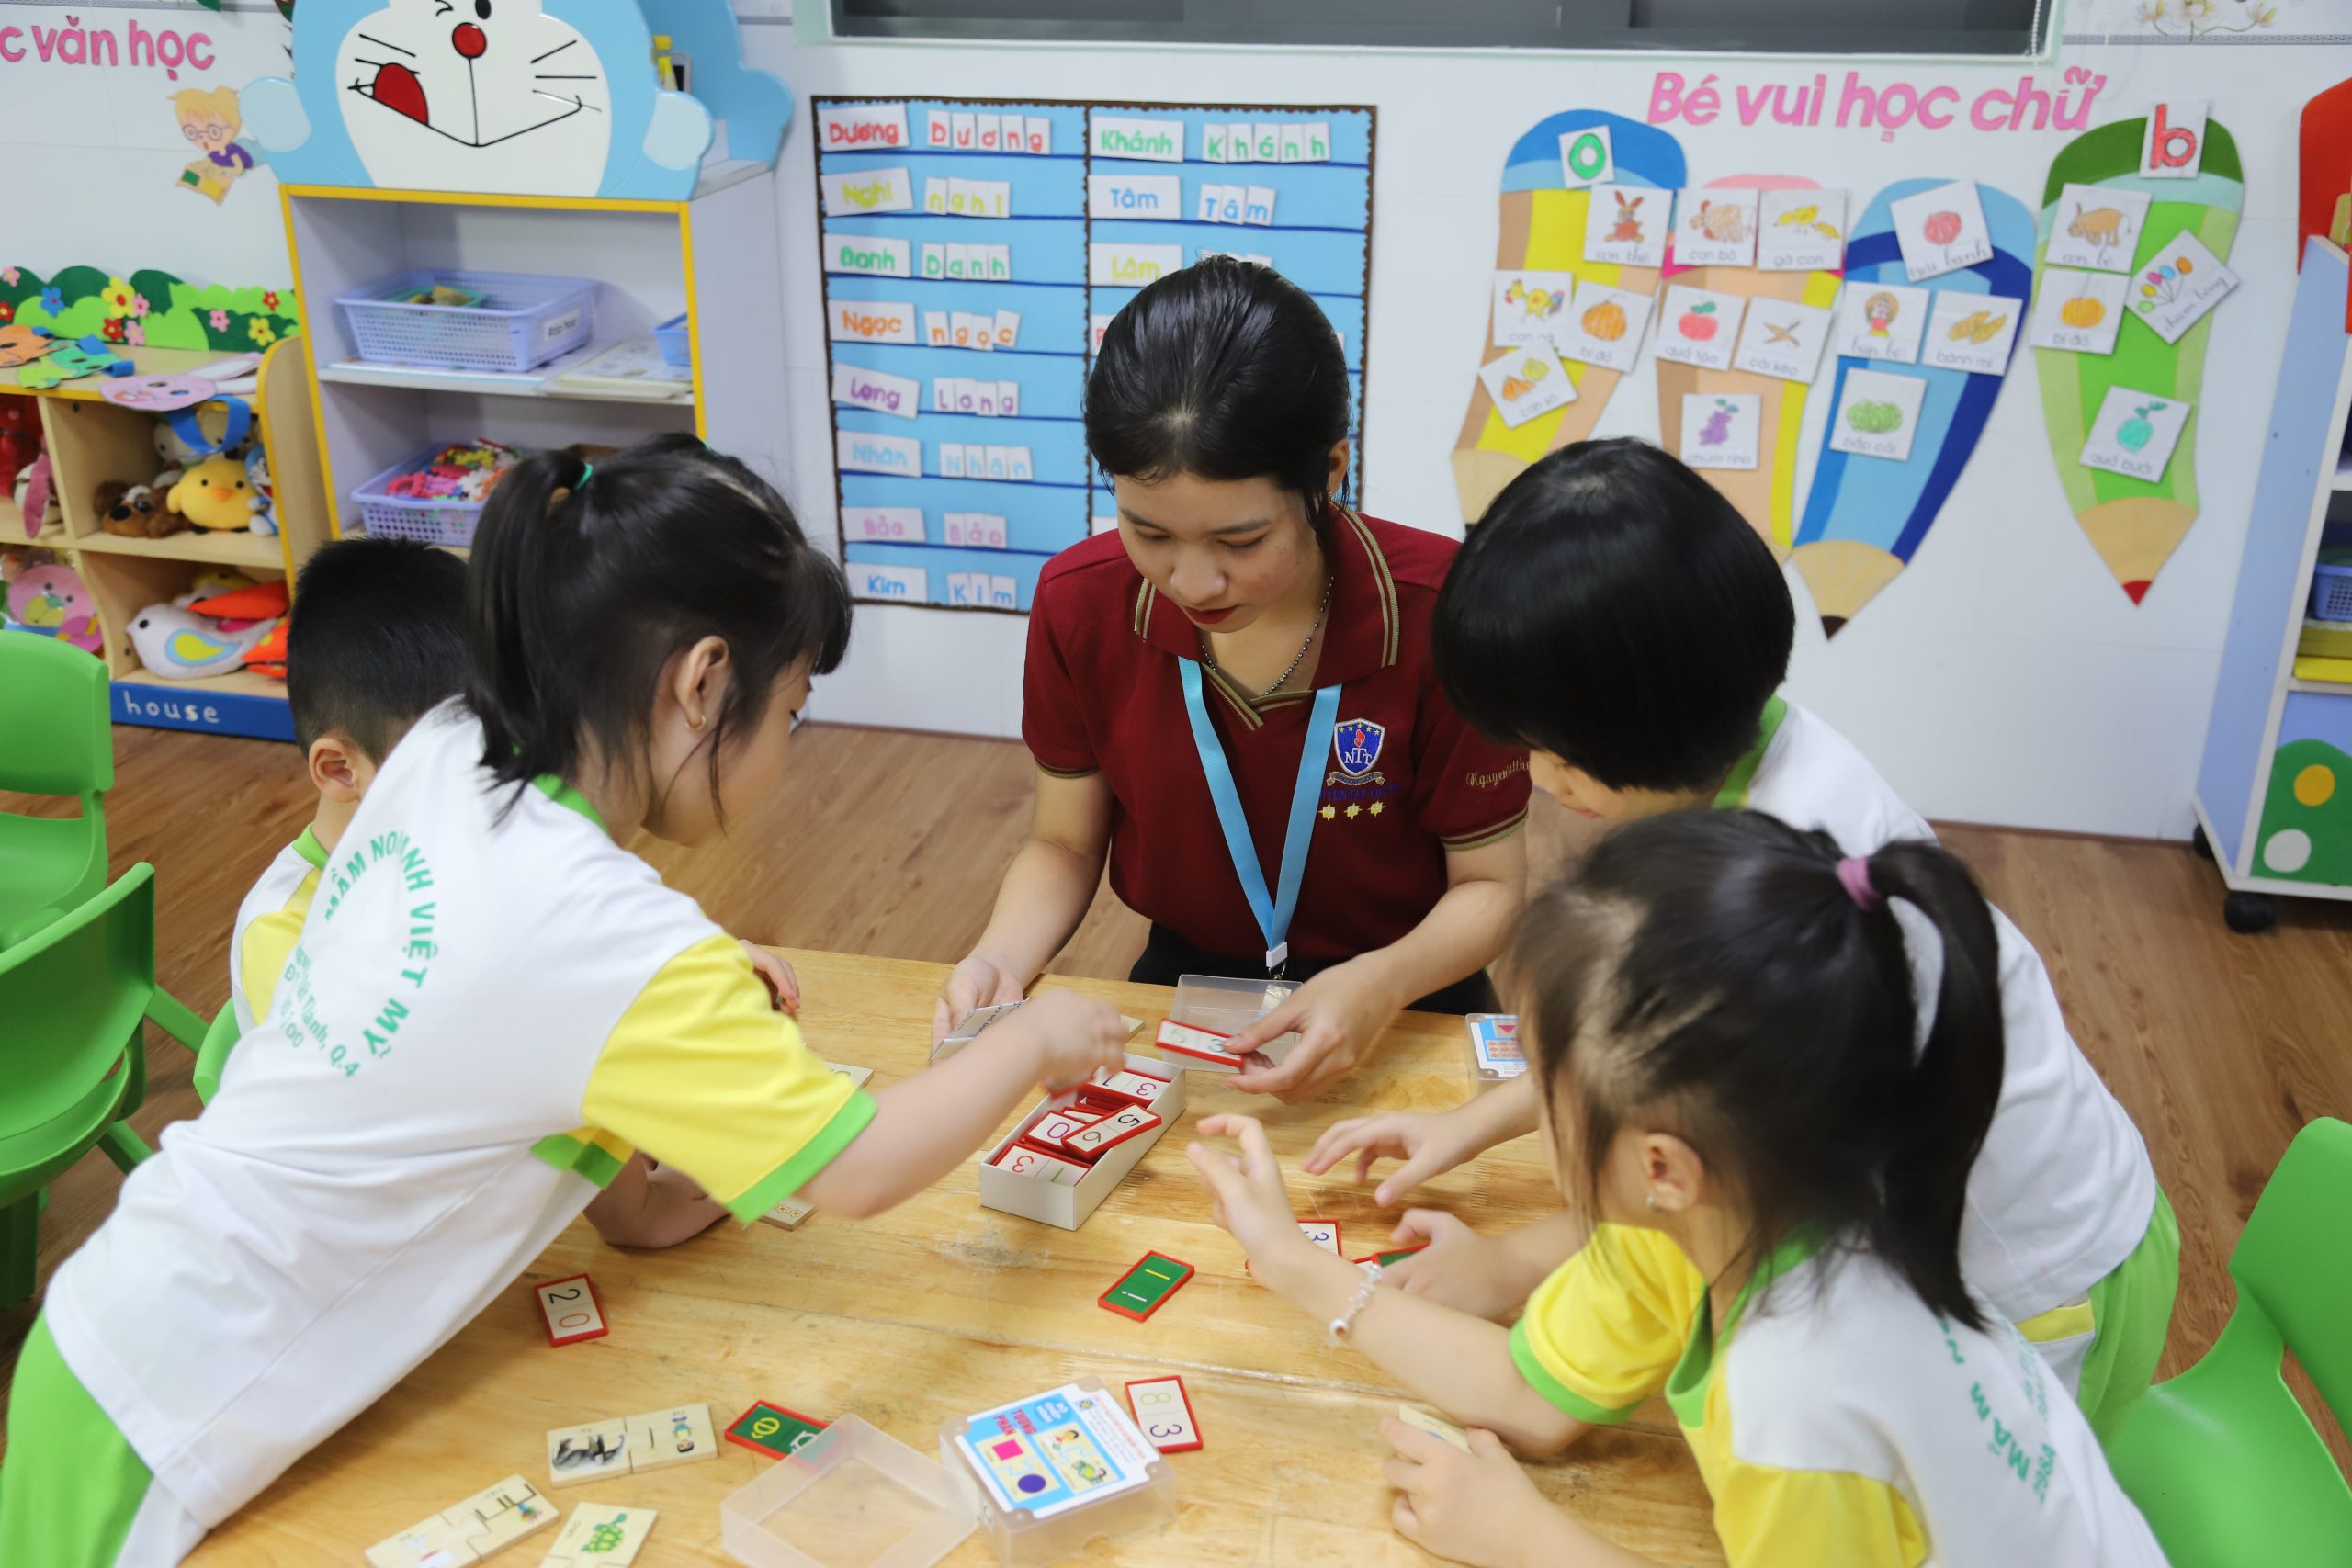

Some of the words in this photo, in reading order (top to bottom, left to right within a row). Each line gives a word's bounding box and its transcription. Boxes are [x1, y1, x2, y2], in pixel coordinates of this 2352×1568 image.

[30, 15, 118, 66] văn
[130, 19, 215, 81] học
[1647, 72, 1721, 125] Bé
[1736, 74, 1826, 126] vui
[1836, 72, 1960, 143] học
[1970, 65, 2107, 131] chữ
[1102, 129, 1173, 154] Khánh
[1207, 136, 1326, 158] Khánh
[2149, 103, 2197, 170] b
[1110, 188, 1159, 209] Tâm
[1204, 197, 1269, 222] Tâm
[840, 245, 896, 272] Danh
[926, 254, 1007, 278] Danh
[842, 310, 902, 337] Ngọc
[931, 325, 1013, 347] ngọc
[937, 389, 1015, 412] Long
[867, 575, 906, 595] Kim
[954, 585, 1012, 602] Kim
[123, 690, 220, 724] house
[401, 900, 439, 989] VIỆT
[363, 998, 411, 1059] MỸ
[1046, 1122, 1071, 1140] 0
[1117, 1113, 1141, 1128] 5
[548, 1287, 582, 1306] 2
[558, 1312, 592, 1330] 0
[1139, 1392, 1172, 1406] 8
[1148, 1423, 1183, 1439] 3
